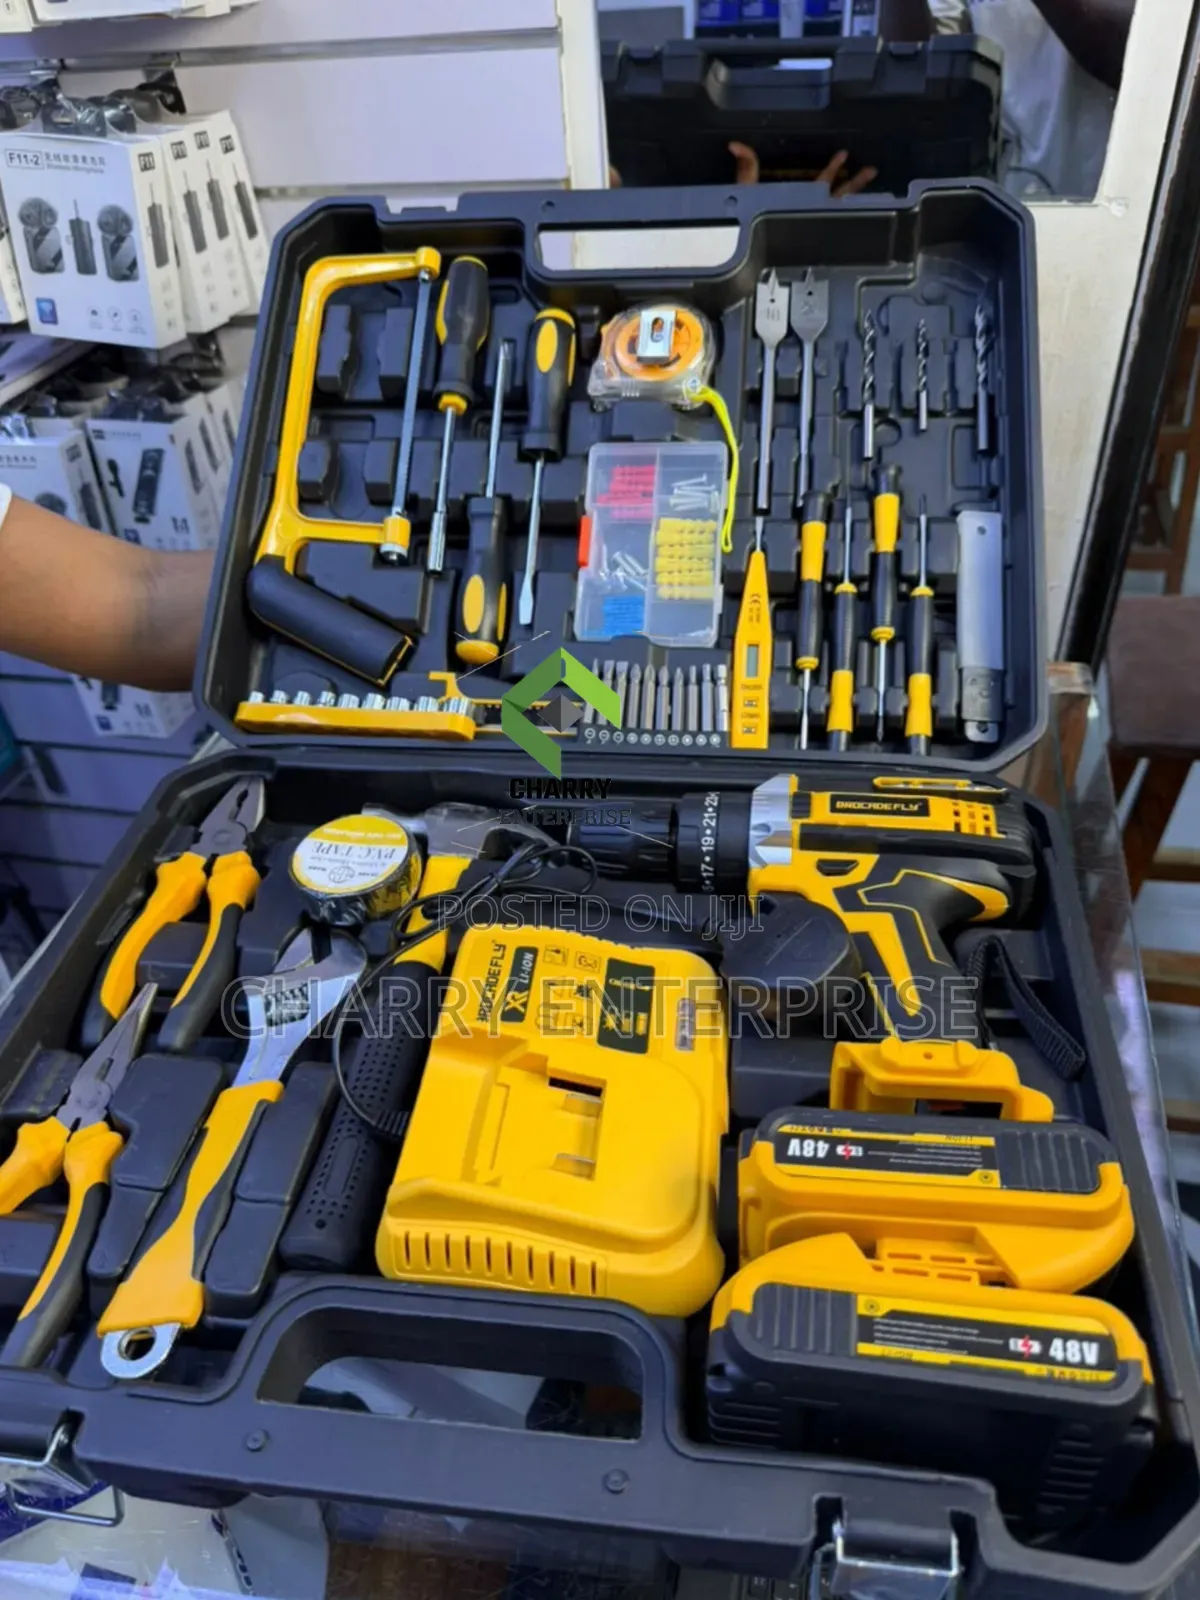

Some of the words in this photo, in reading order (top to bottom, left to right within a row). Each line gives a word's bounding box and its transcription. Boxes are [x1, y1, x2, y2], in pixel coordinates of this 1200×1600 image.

[8, 152, 40, 166] F11-2
[702, 812, 717, 827] 21
[312, 842, 353, 857] TAPE
[701, 838, 715, 853] 19
[701, 864, 714, 877] 17
[520, 952, 534, 984] LI-ION
[787, 1138, 830, 1158] 48V
[1049, 1337, 1099, 1366] 48V
